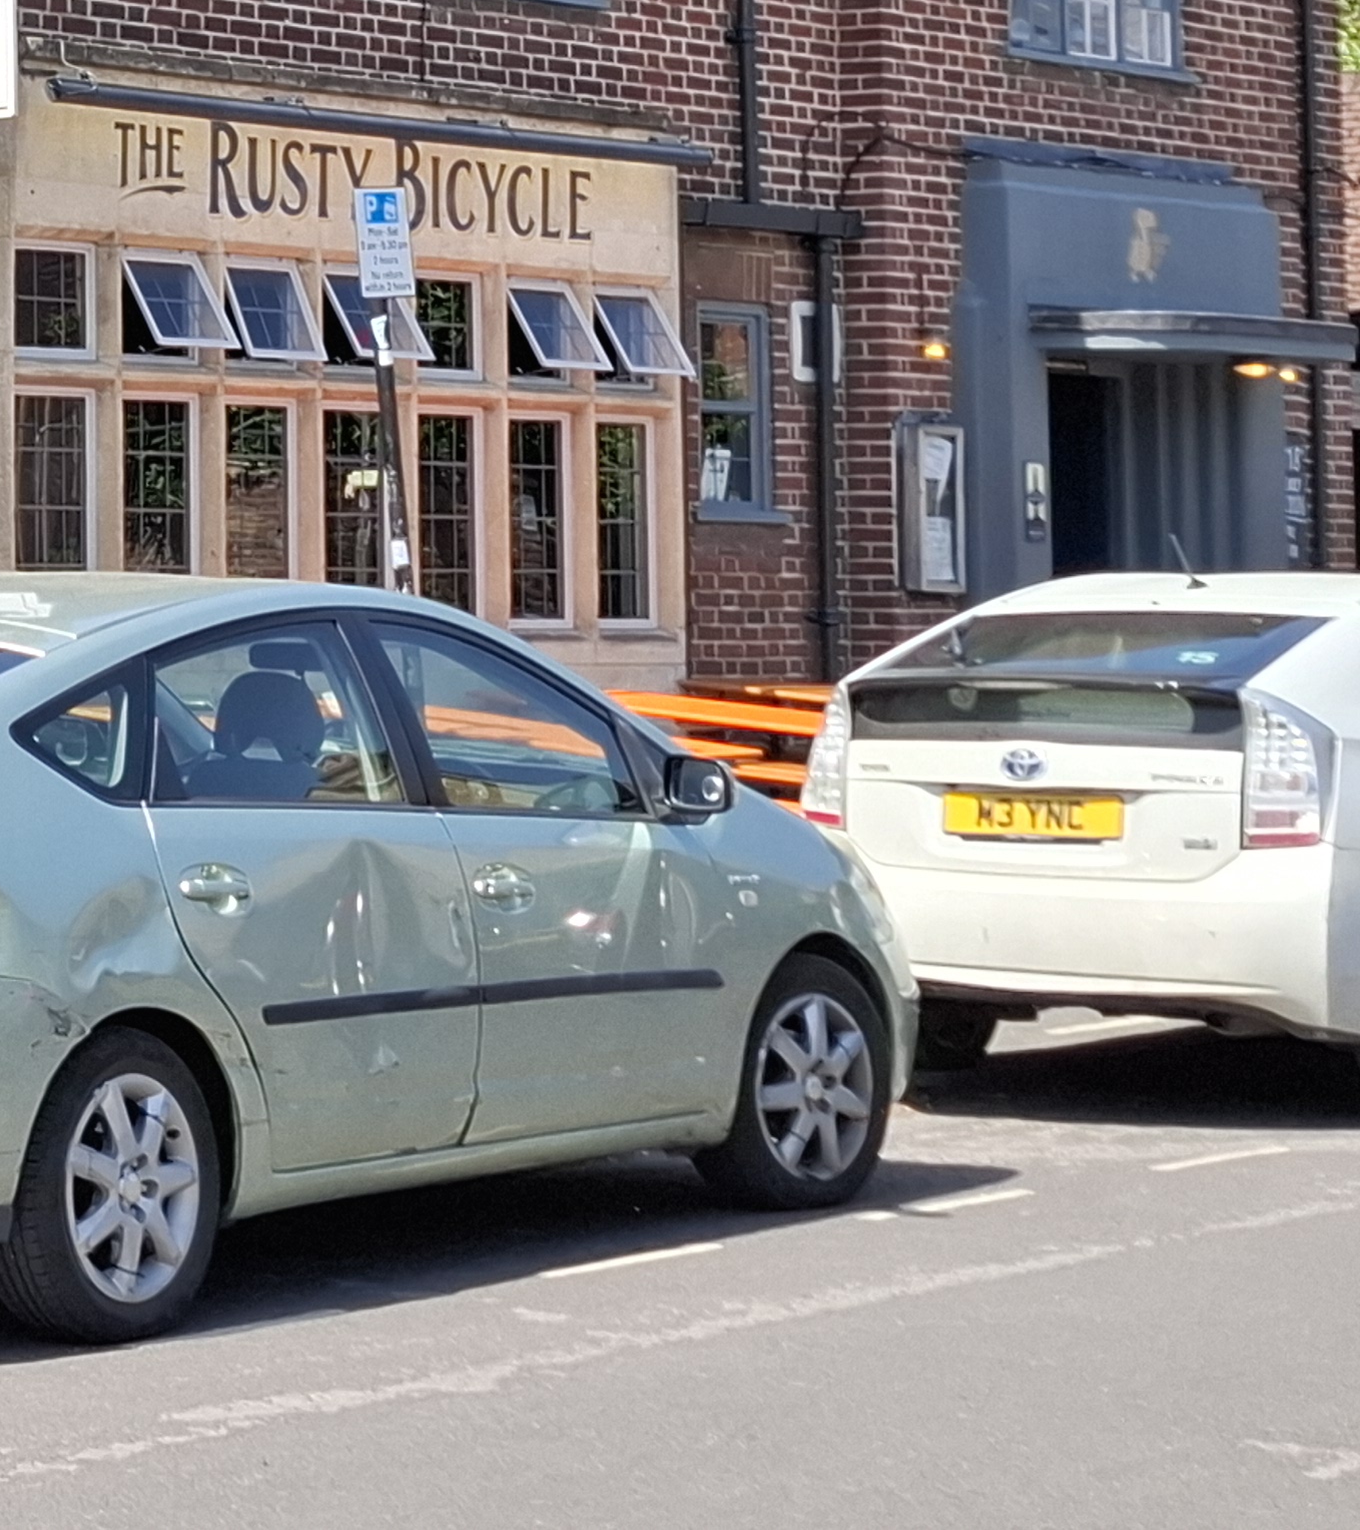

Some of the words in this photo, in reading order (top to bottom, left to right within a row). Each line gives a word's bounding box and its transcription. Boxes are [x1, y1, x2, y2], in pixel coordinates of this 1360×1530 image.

[114, 121, 184, 188] THE
[209, 120, 373, 220] RUSTY
[396, 139, 592, 240] BICYCLE
